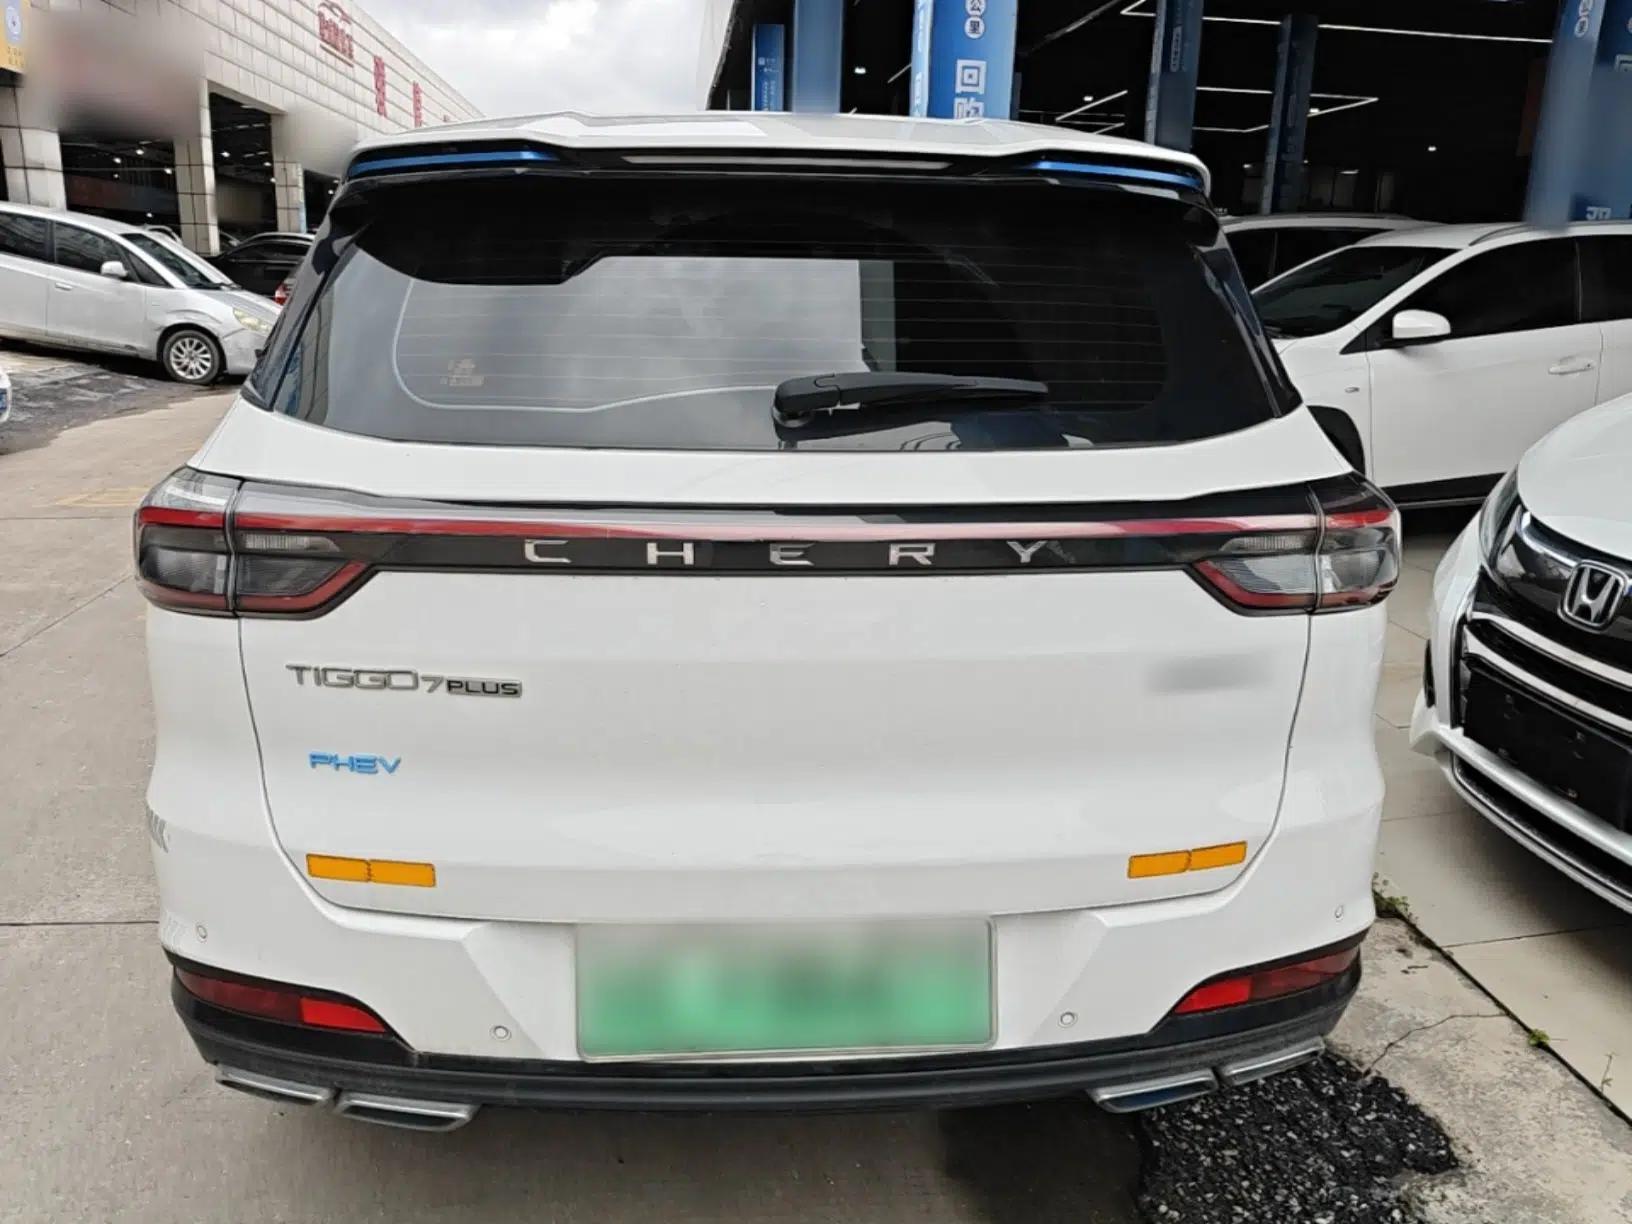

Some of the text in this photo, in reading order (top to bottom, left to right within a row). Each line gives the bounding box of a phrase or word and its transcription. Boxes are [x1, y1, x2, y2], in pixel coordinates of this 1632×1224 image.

[523, 538, 1048, 568] CHERY
[285, 663, 419, 691] TIGGO
[446, 677, 522, 698] PLUS
[309, 752, 401, 775] PHEV
